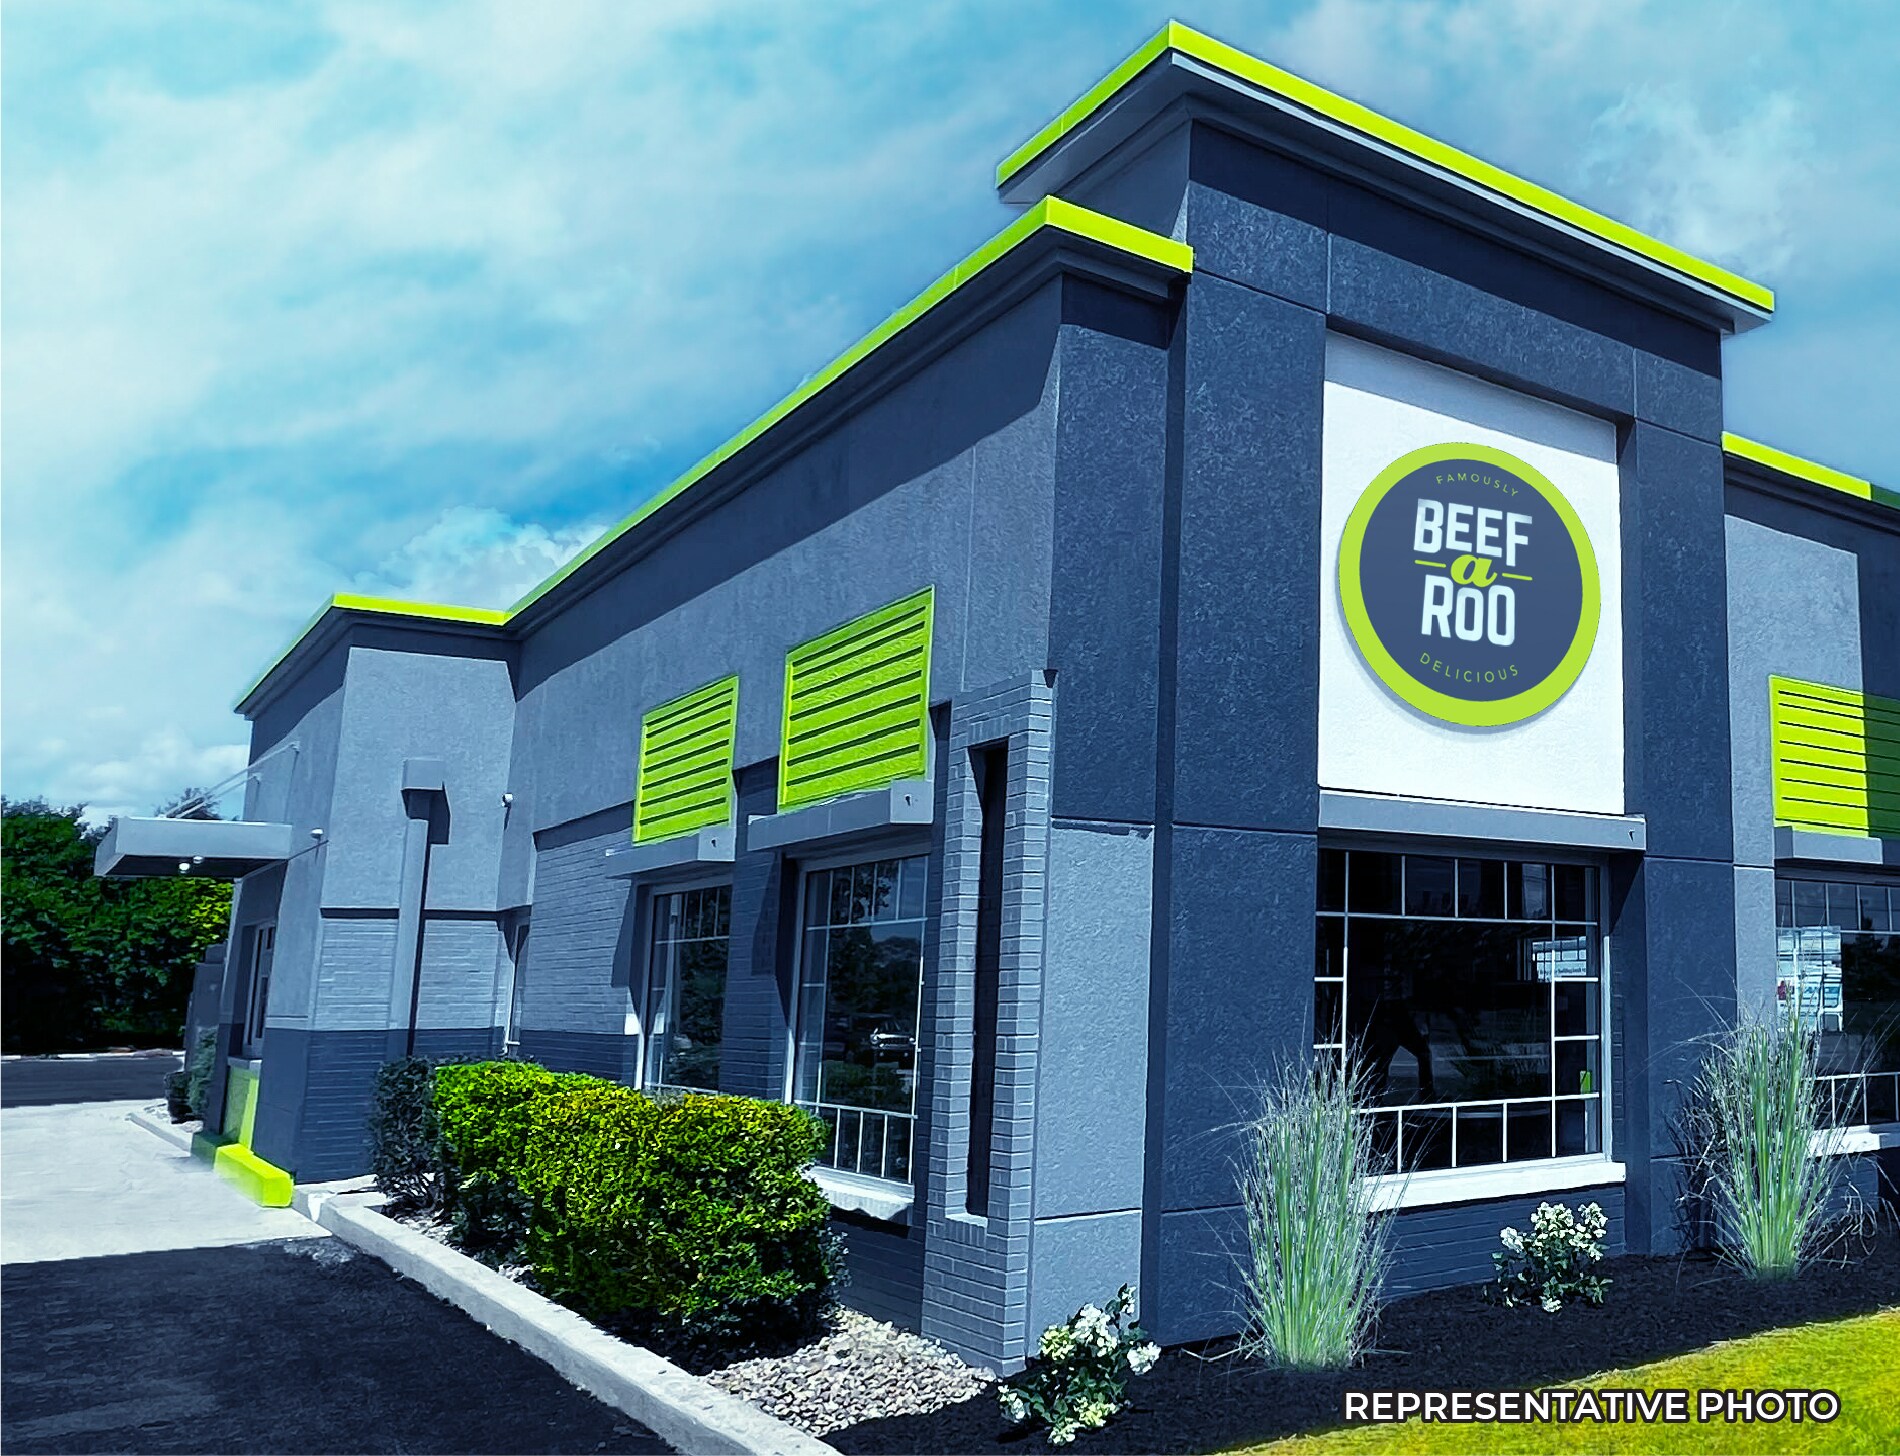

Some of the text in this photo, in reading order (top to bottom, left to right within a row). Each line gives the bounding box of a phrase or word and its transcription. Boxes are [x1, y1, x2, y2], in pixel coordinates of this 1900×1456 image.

[1436, 473, 1519, 497] FAMOUSLY
[1414, 498, 1533, 567] BEEF
[1451, 555, 1498, 588] a
[1421, 574, 1515, 646] ROO
[1420, 652, 1519, 683] DELICIOUS
